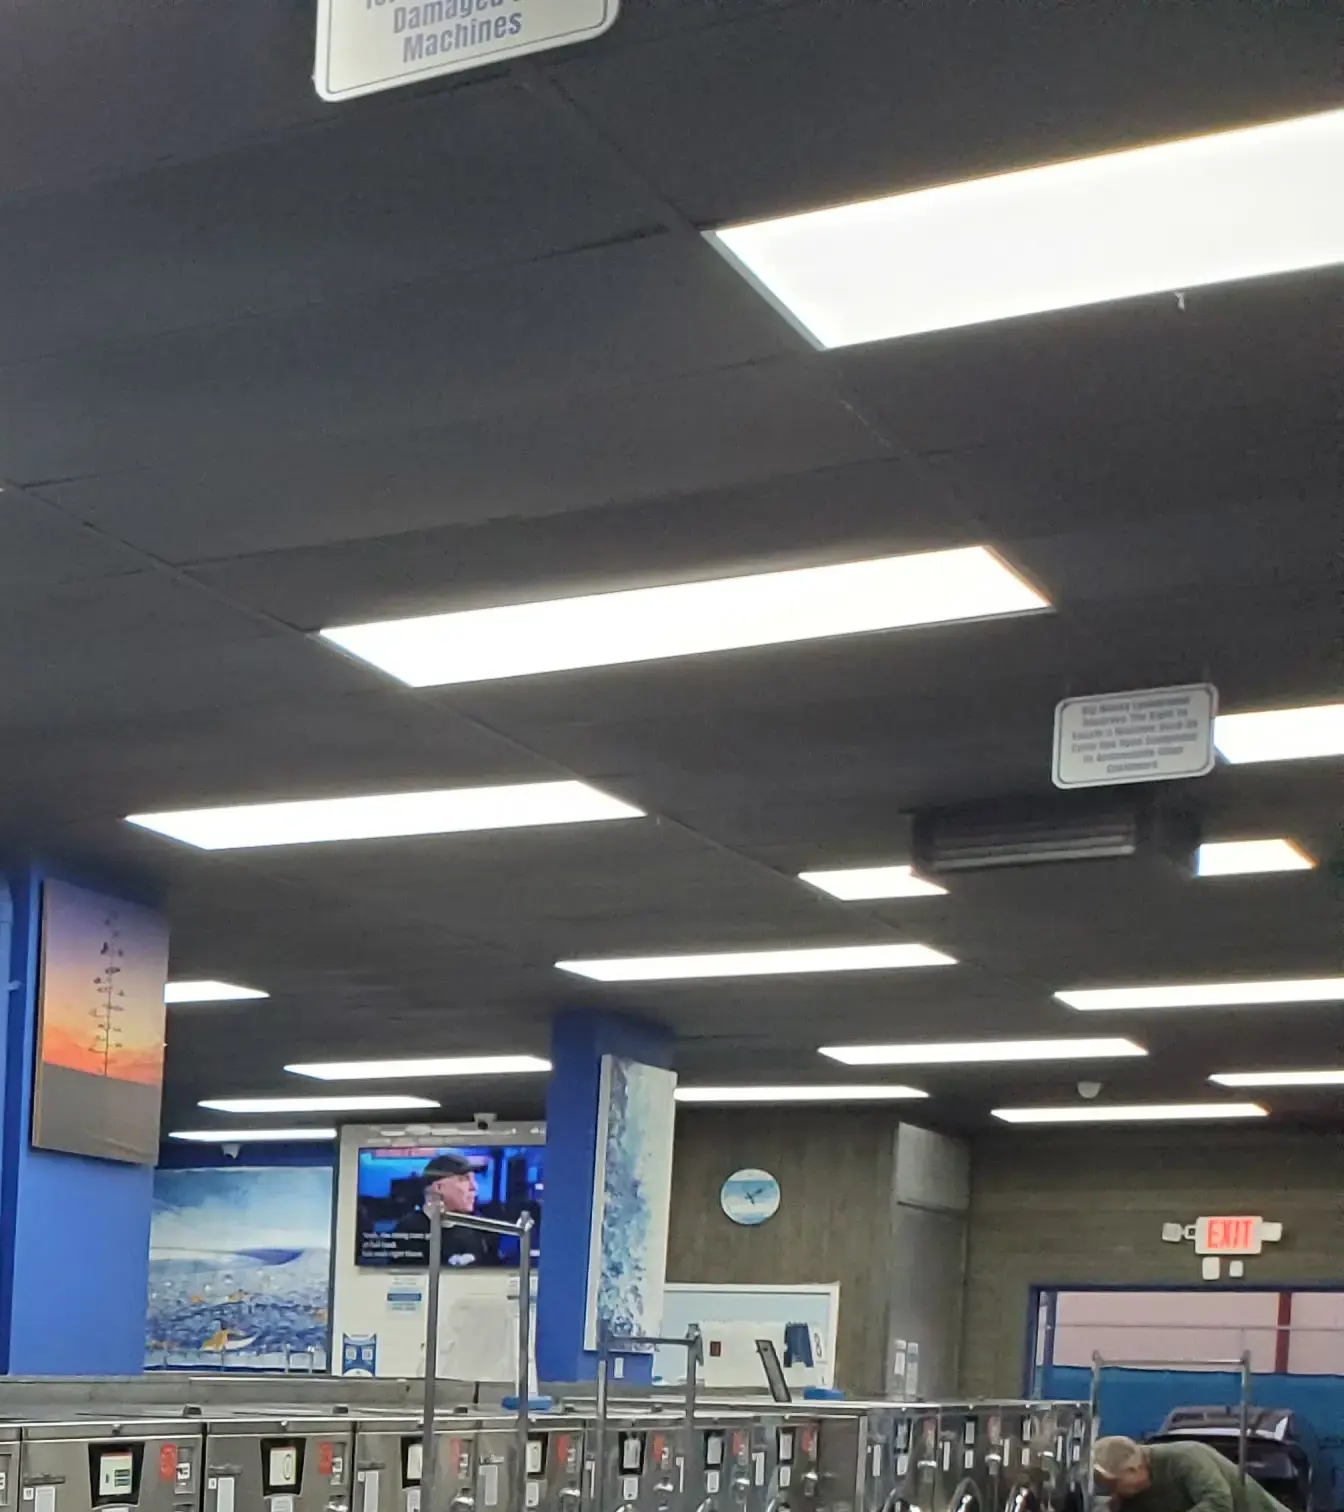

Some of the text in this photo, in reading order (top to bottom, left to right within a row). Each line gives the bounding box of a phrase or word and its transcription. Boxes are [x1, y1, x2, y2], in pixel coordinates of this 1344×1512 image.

[393, 0, 504, 34] Damage
[402, 12, 522, 63] Machines
[1207, 1219, 1254, 1248] EXIT
